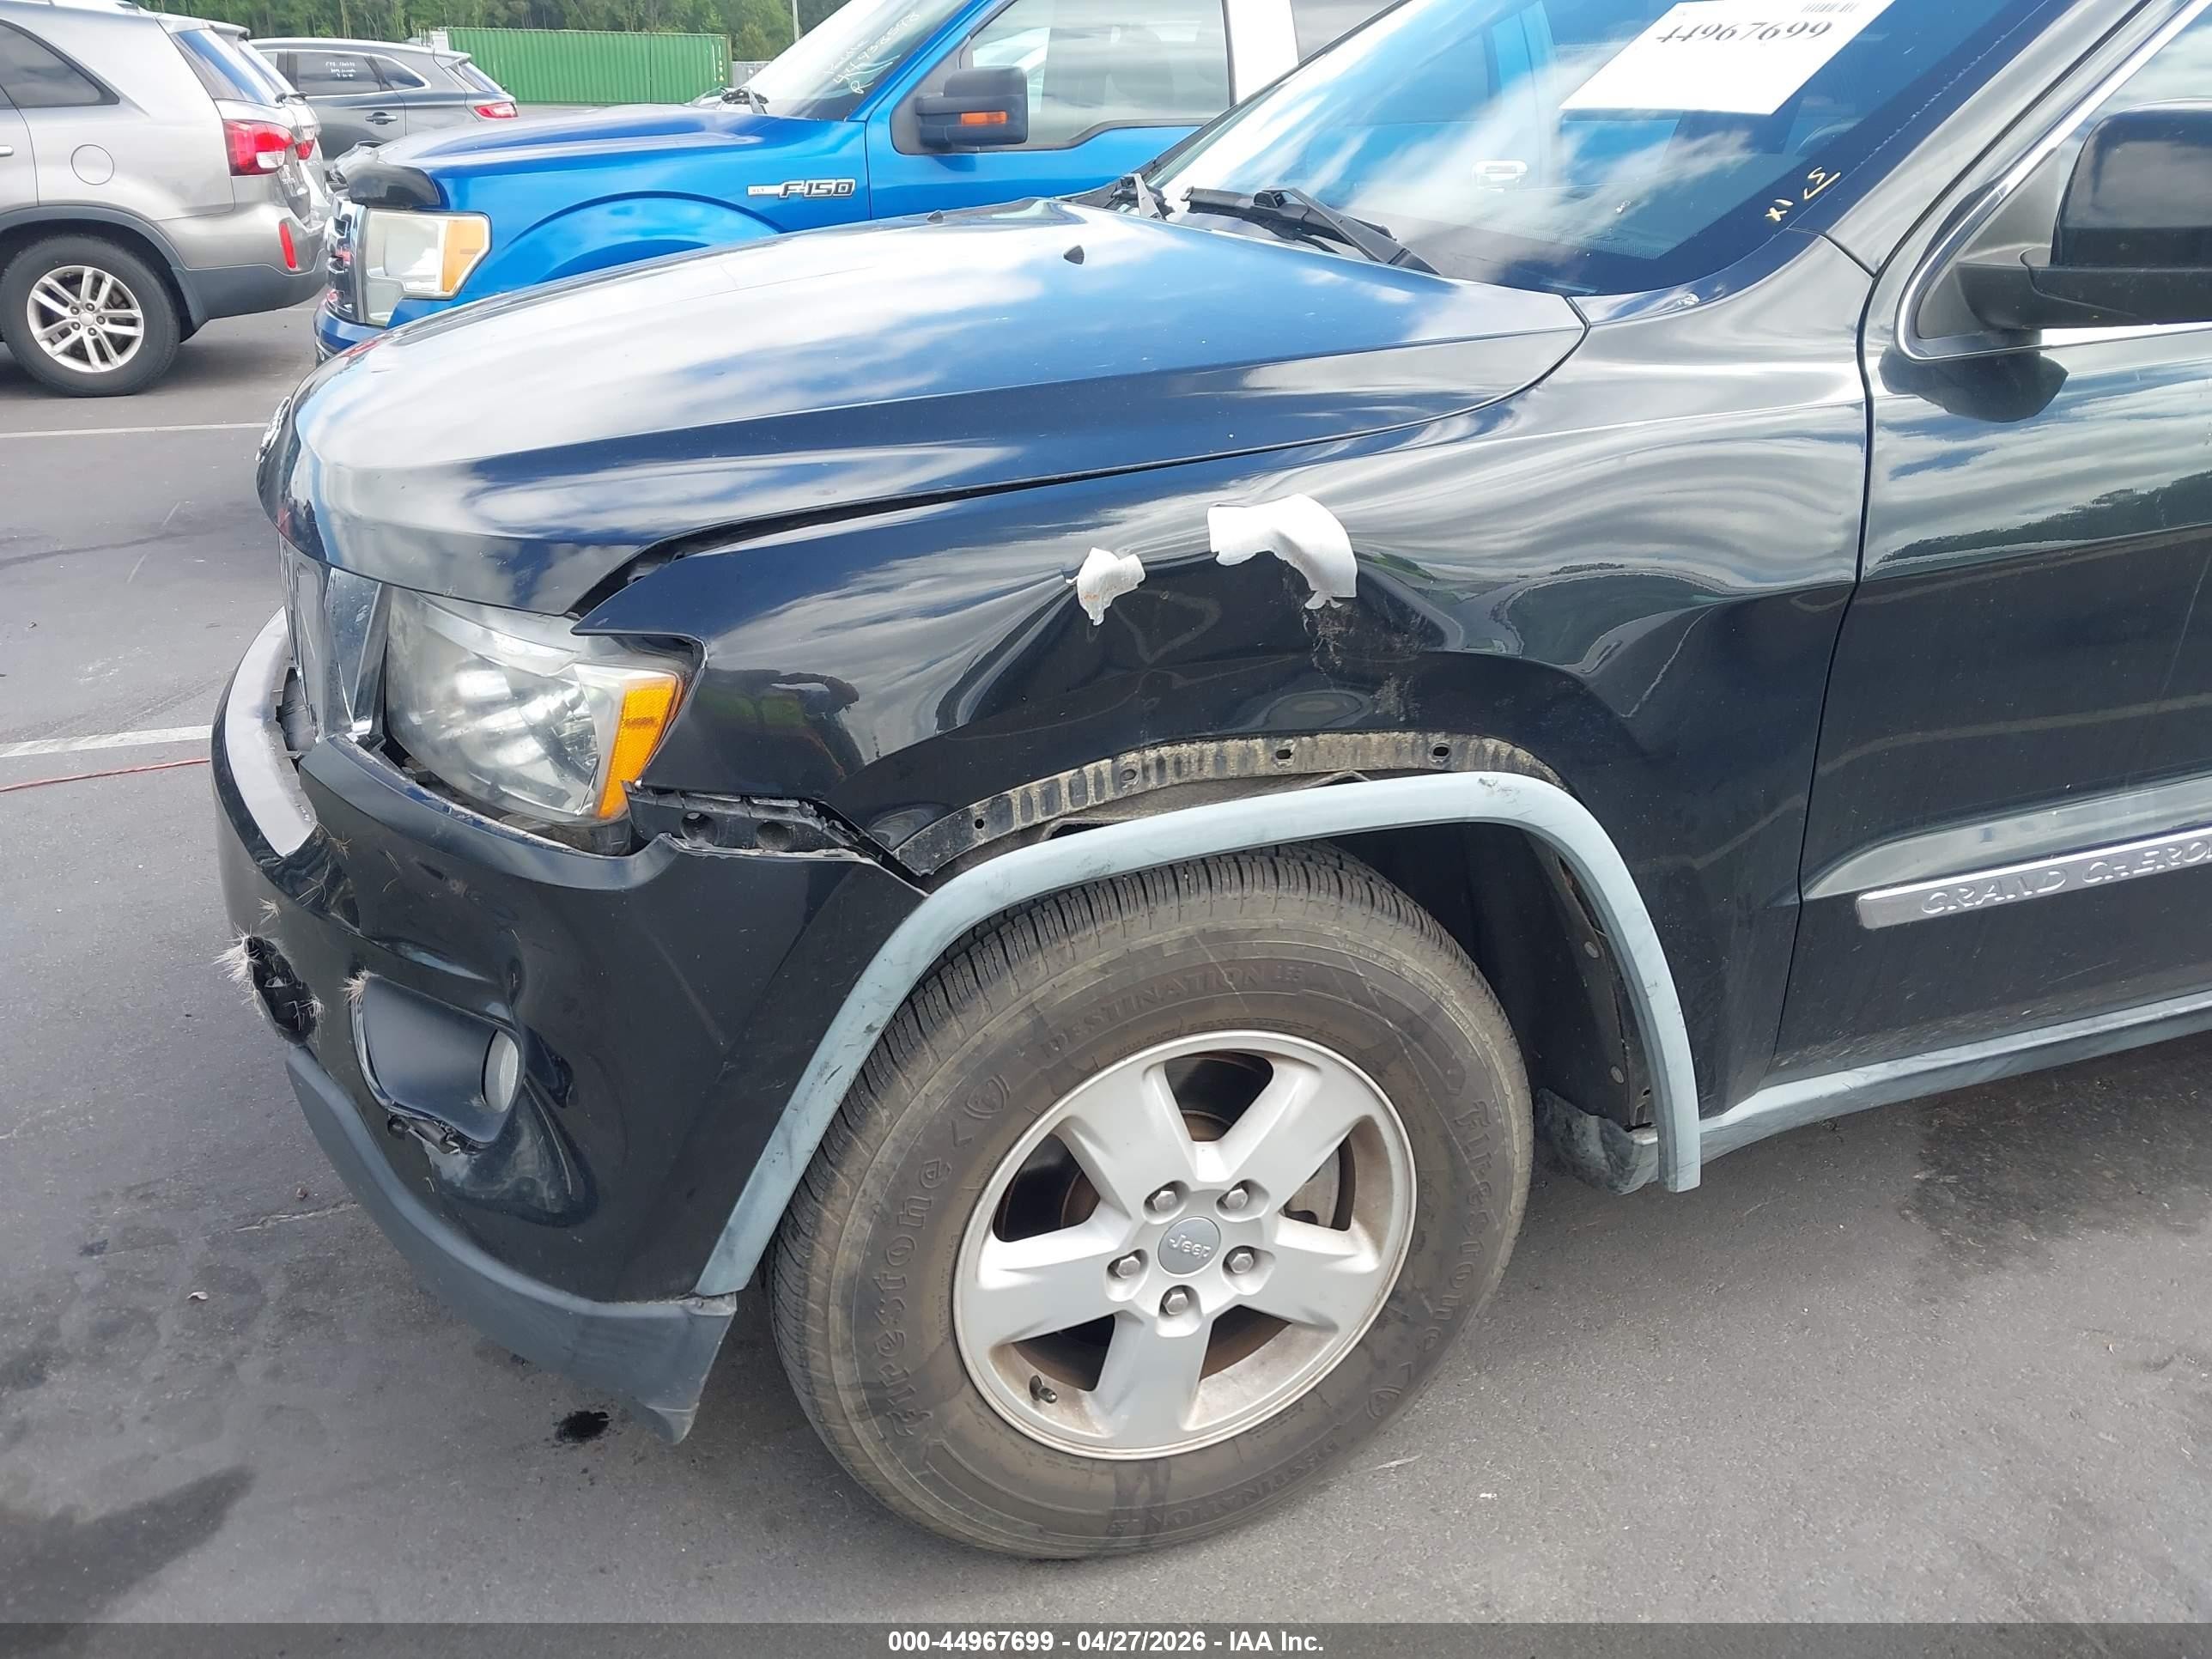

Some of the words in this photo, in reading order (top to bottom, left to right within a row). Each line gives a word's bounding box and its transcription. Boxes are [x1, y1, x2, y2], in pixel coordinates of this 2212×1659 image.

[1656, 21, 1833, 43] 44967699
[779, 178, 856, 198] F-150
[1921, 865, 2068, 915] GRAND
[2081, 841, 2212, 884] CHERO
[1040, 963, 1266, 1060] DESTINATION
[1169, 1233, 1212, 1260] Jeep
[1423, 1099, 1492, 1352] Firestone
[870, 1158, 954, 1438] Firestone
